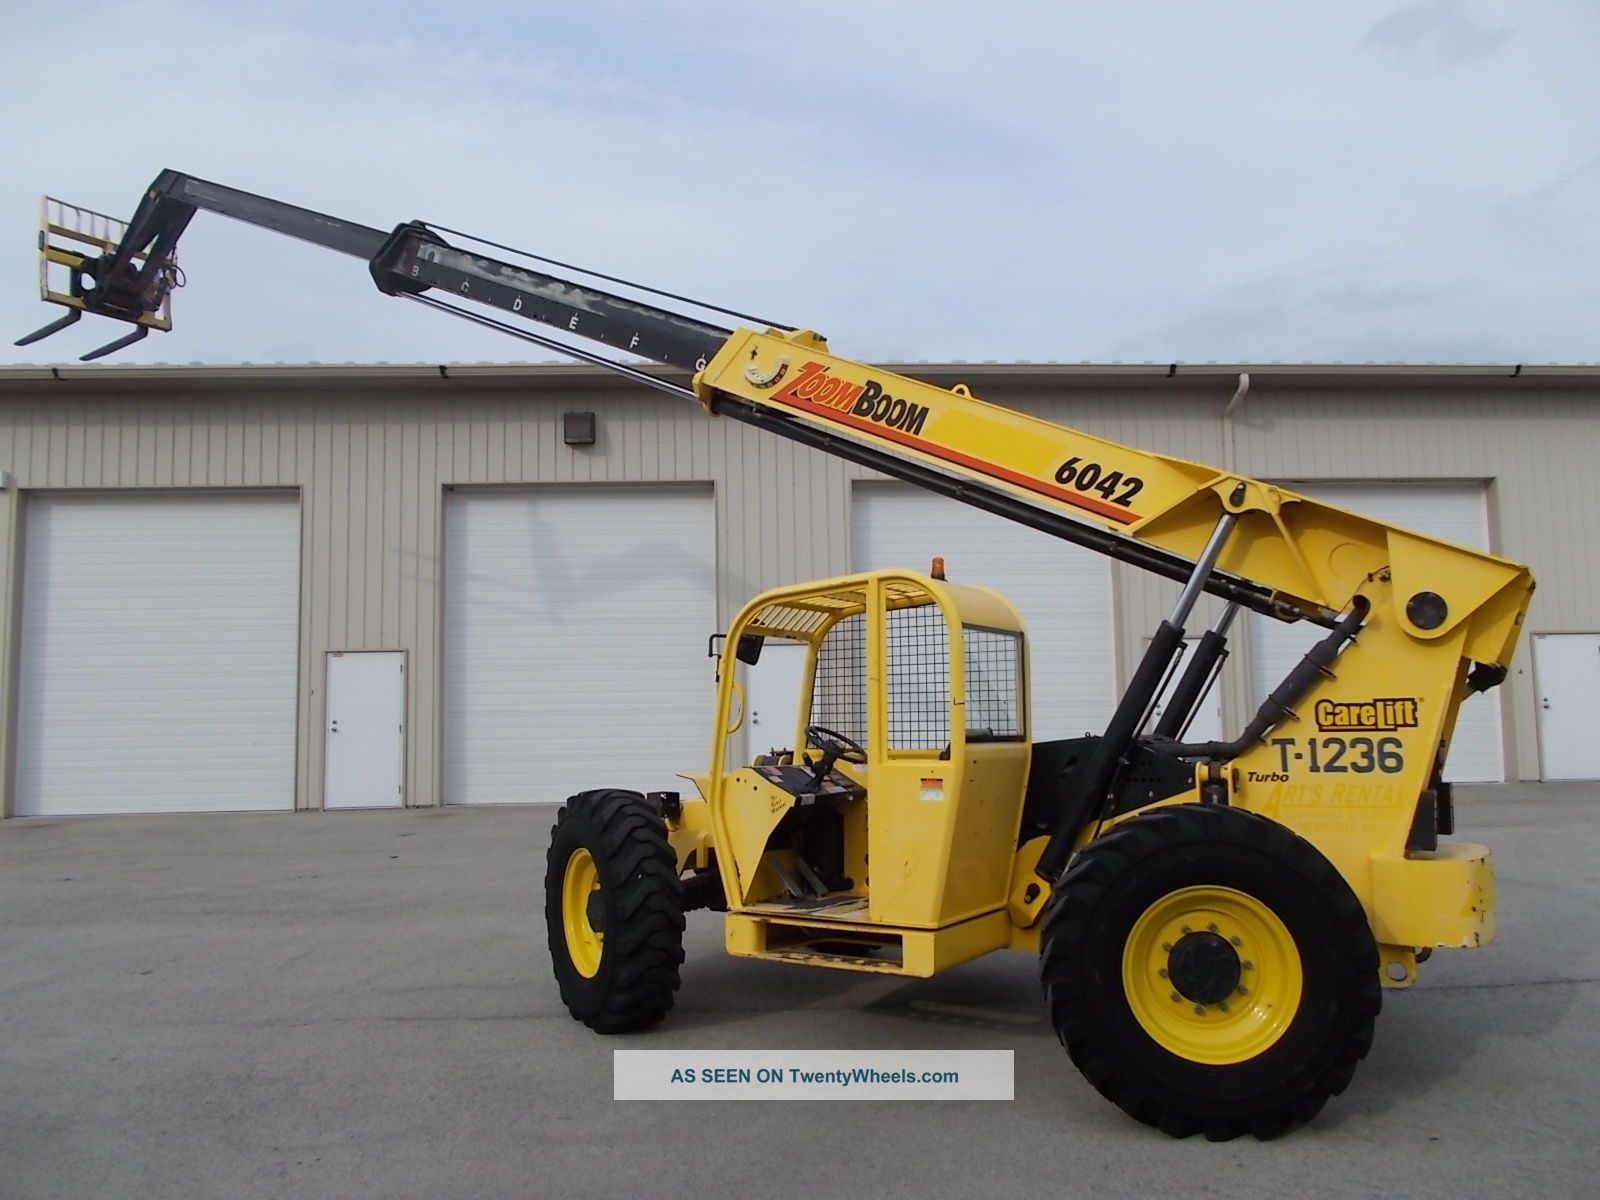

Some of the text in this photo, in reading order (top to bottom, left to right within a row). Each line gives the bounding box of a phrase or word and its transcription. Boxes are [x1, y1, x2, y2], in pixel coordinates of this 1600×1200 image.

[411, 265, 419, 276] B
[513, 298, 522, 311] D
[569, 316, 579, 329] E
[629, 336, 640, 349] F
[695, 358, 707, 371] G
[1055, 457, 1144, 508] 6042
[1315, 699, 1418, 732] CareLift
[1272, 737, 1404, 773] T-1236
[1248, 772, 1290, 783] Turbo
